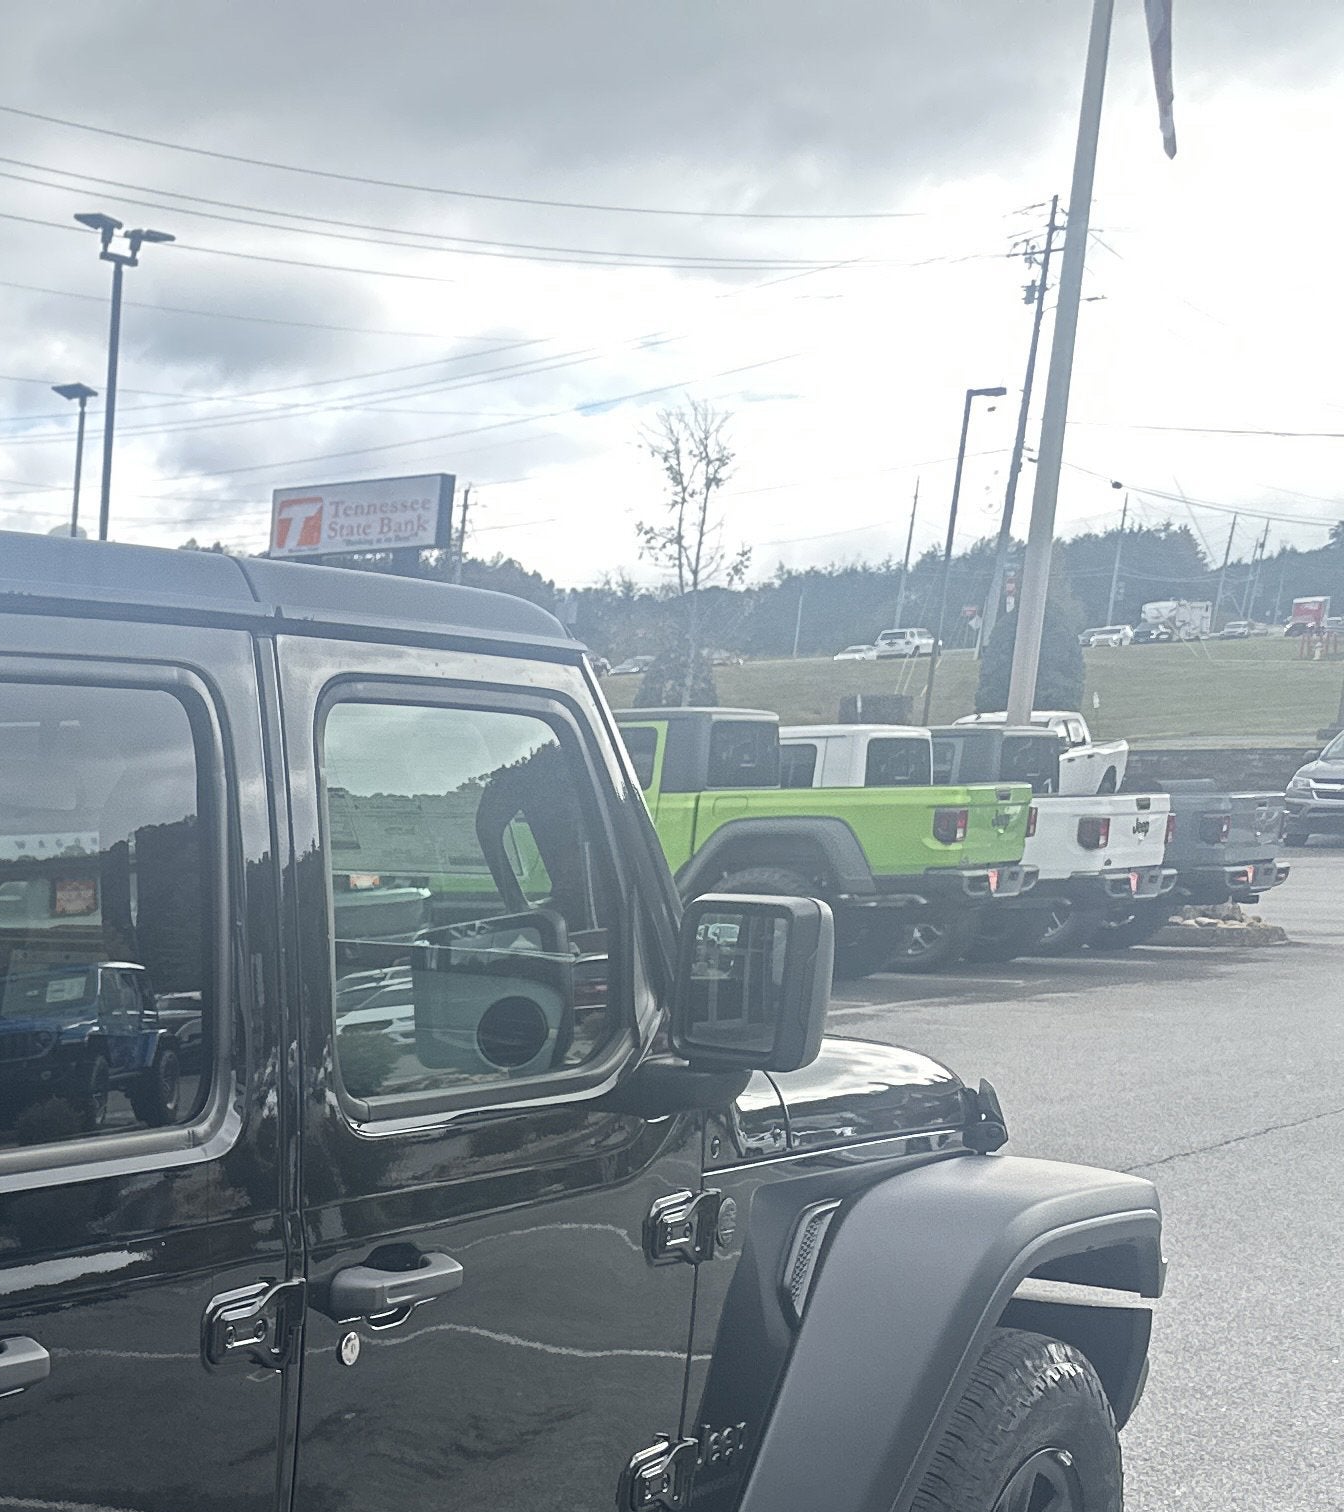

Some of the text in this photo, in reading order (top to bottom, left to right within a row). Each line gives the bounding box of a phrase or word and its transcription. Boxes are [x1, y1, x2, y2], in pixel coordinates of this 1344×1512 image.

[328, 498, 431, 519] Tennessee
[327, 518, 371, 540] State
[378, 514, 429, 537] Bank
